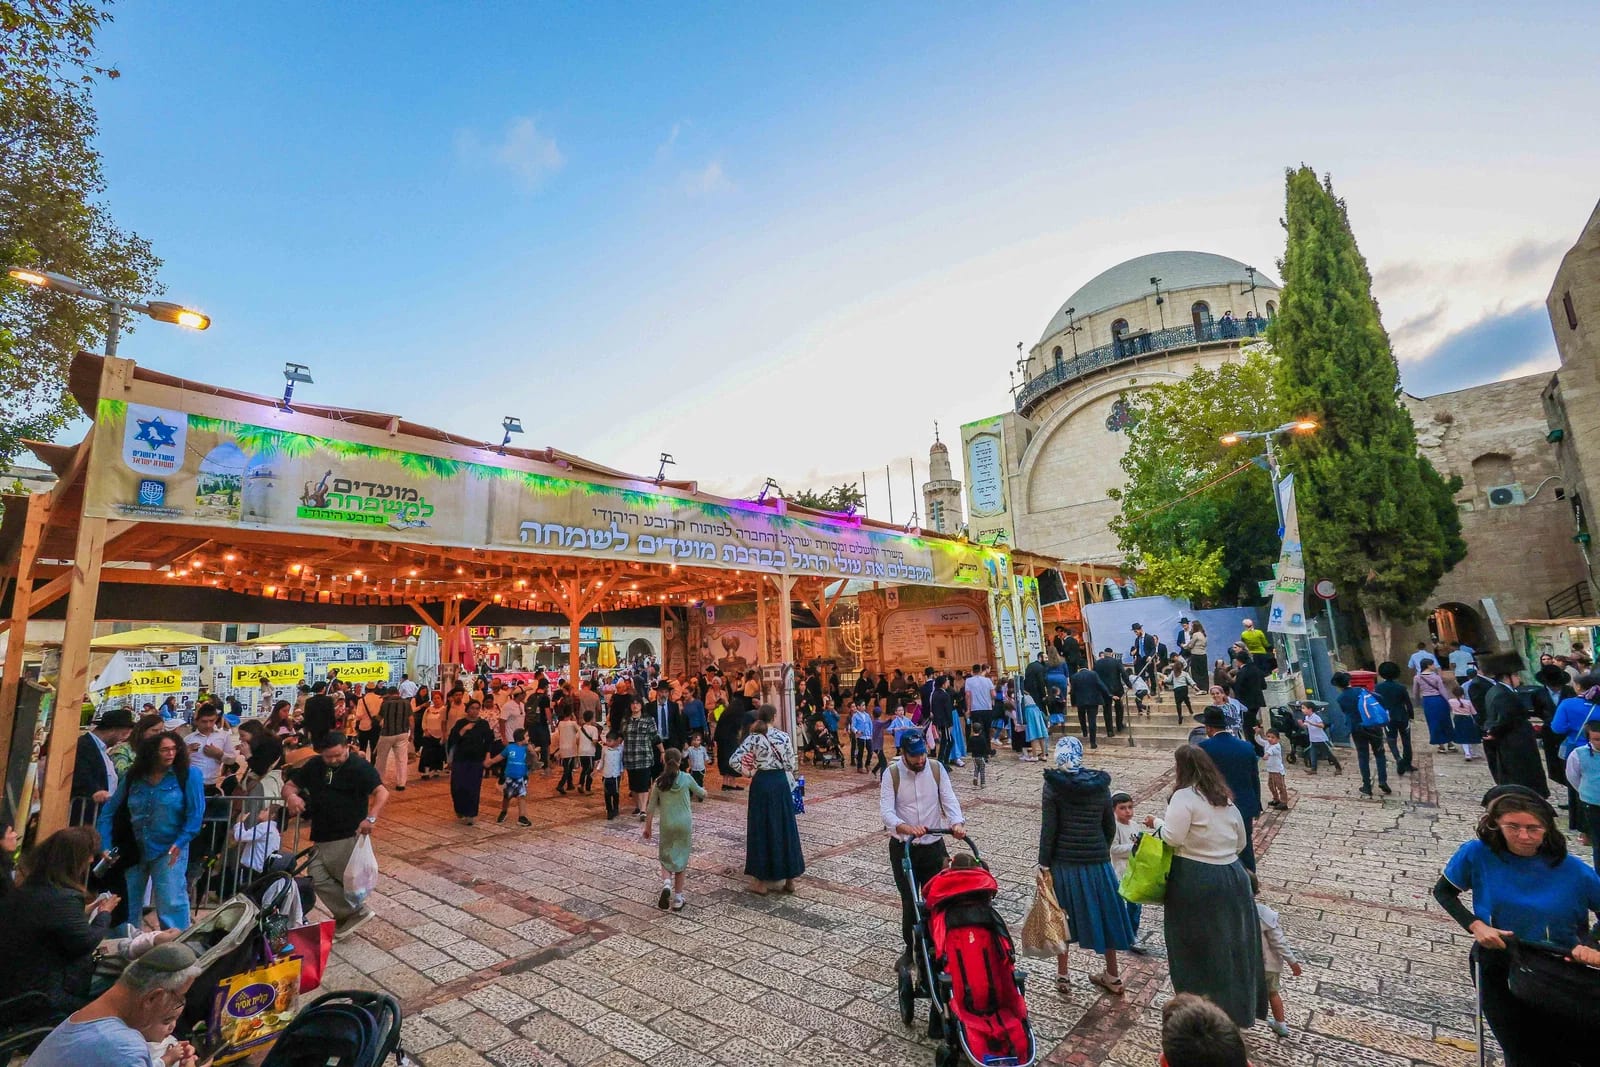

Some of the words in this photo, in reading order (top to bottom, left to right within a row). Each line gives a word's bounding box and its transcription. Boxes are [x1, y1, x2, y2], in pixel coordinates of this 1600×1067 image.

[333, 478, 418, 502] מועדים
[304, 508, 343, 520] היהודי
[325, 492, 435, 518] למשפחה
[592, 508, 639, 526] היהודי
[644, 515, 686, 531] הרובע
[519, 520, 630, 552] לשמחה
[690, 521, 732, 537] לפיתוח
[736, 528, 778, 543] והחברה
[780, 530, 813, 547] ישראל
[637, 534, 717, 561] מועדים
[815, 539, 848, 552] ומסורת
[722, 544, 786, 568] בברכת
[789, 544, 830, 571] הרגל
[833, 552, 862, 574] עולי
[865, 560, 885, 576] את
[886, 559, 933, 581] מקבלים
